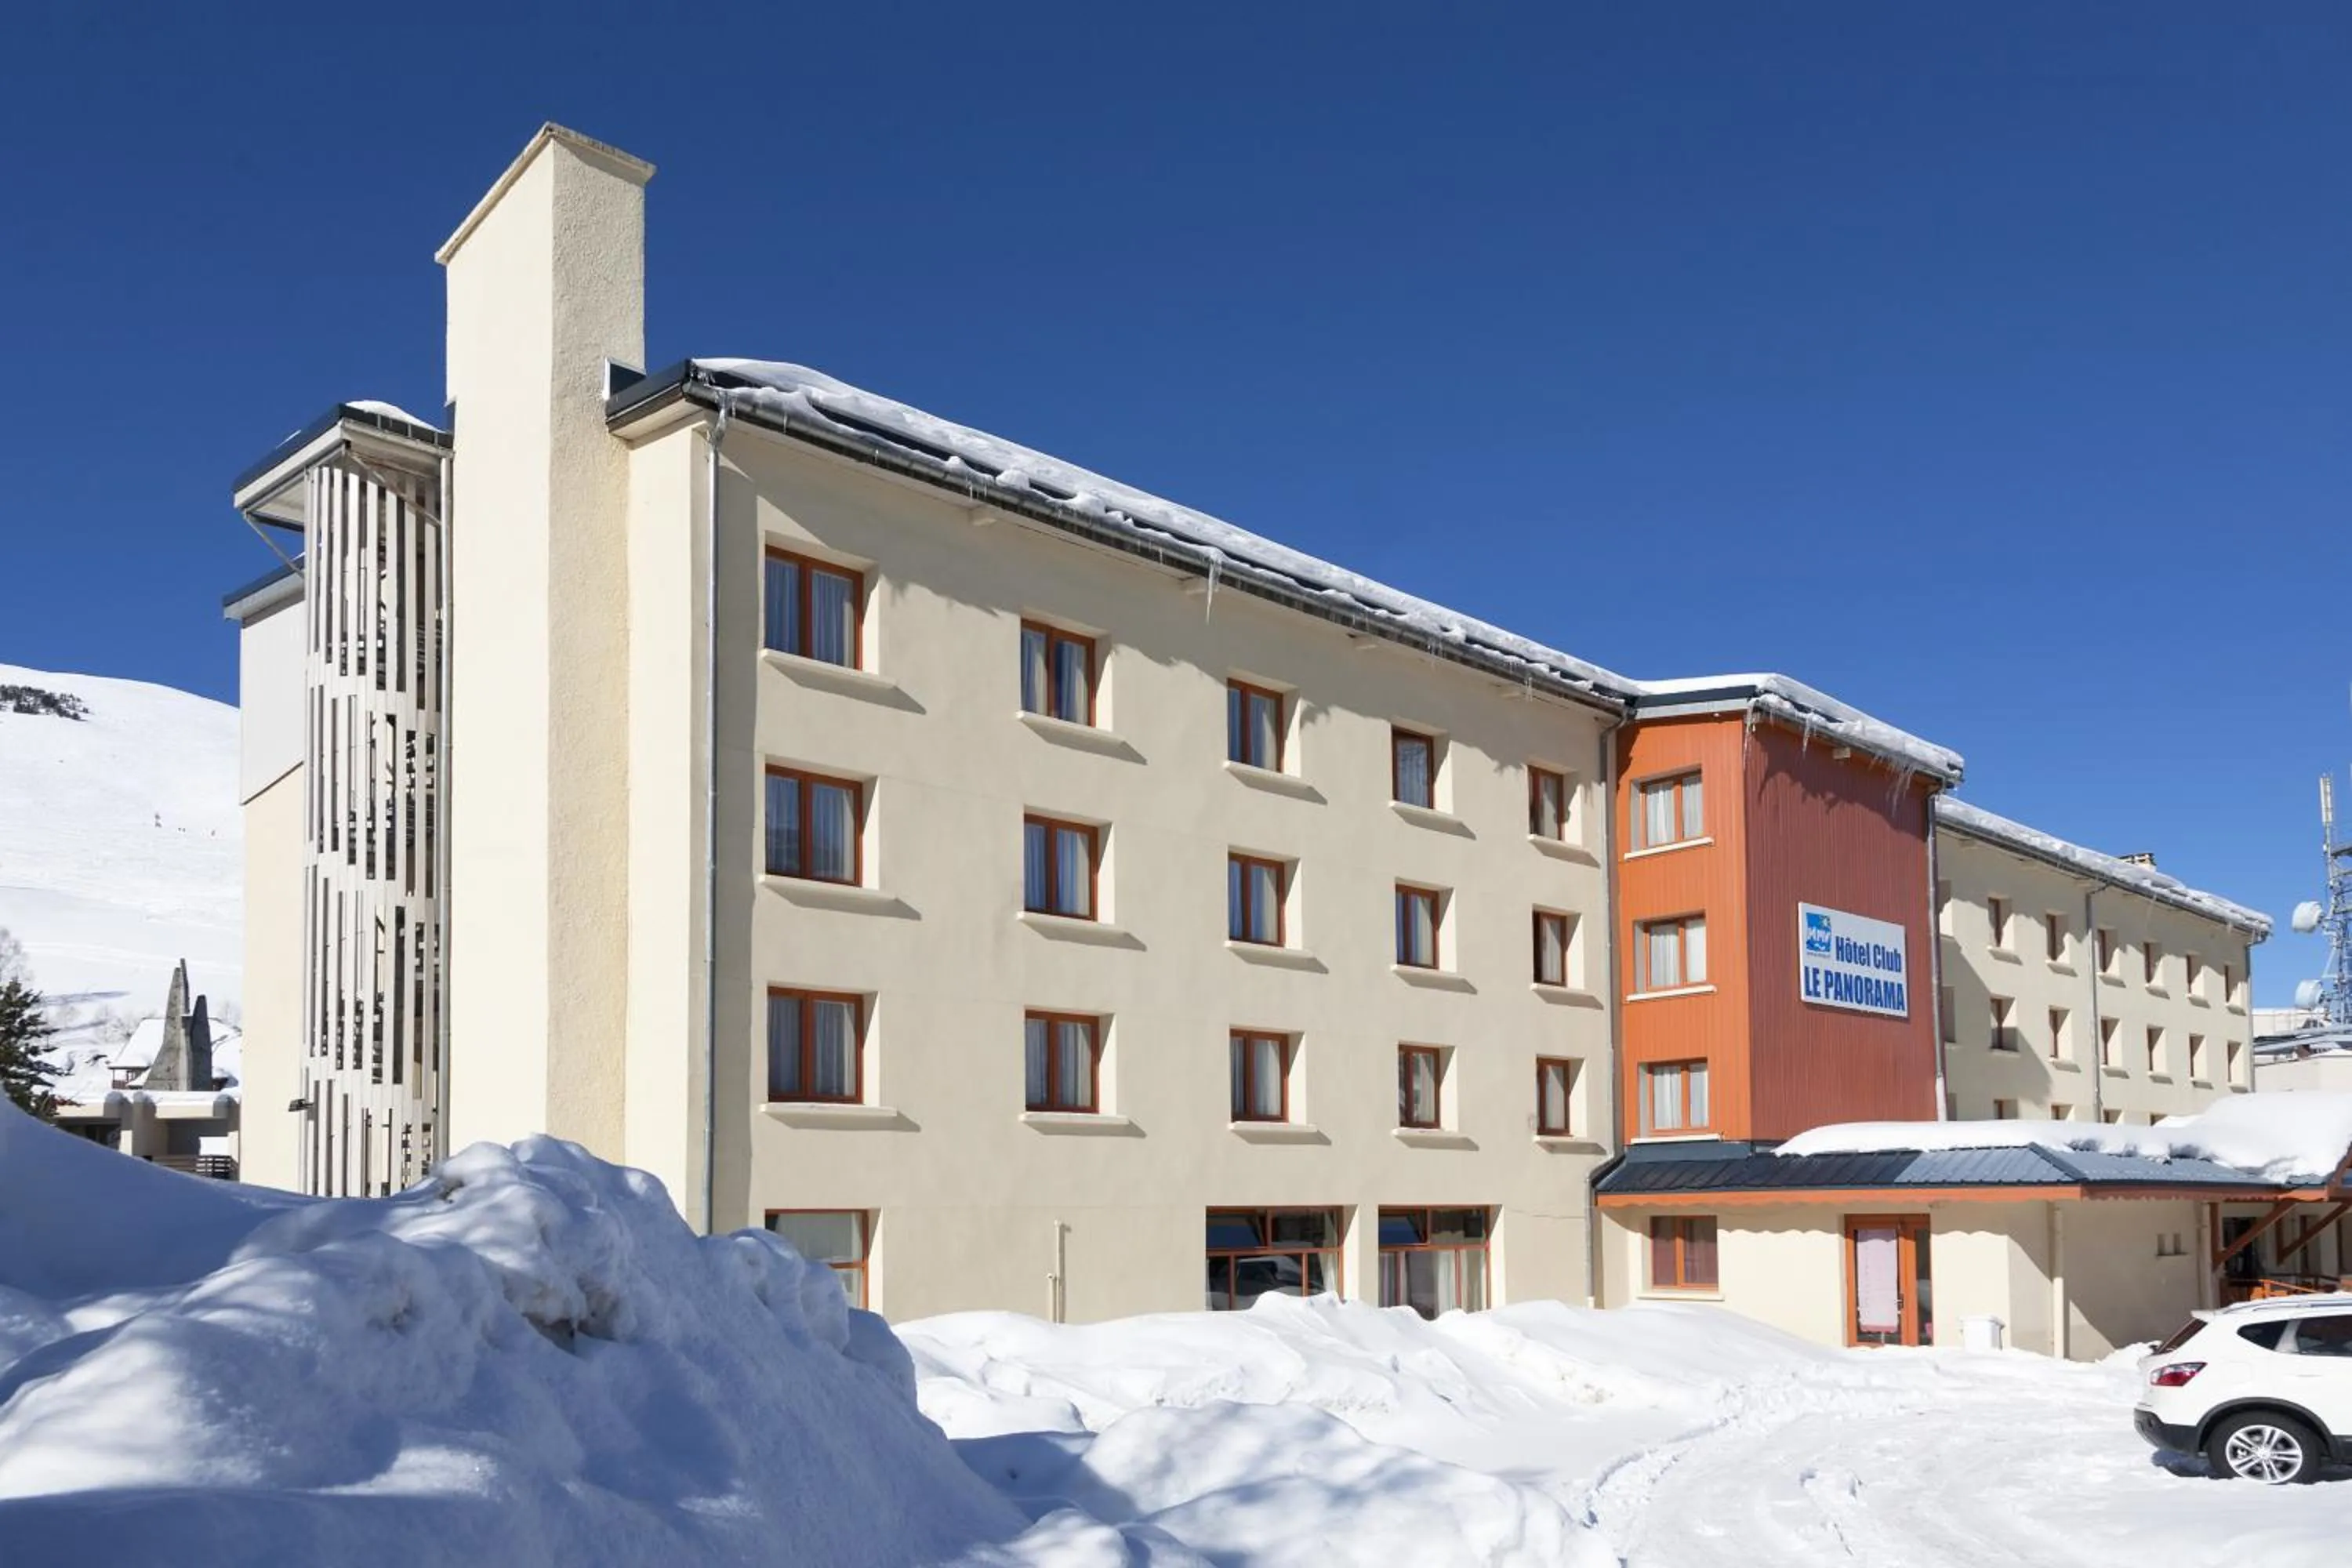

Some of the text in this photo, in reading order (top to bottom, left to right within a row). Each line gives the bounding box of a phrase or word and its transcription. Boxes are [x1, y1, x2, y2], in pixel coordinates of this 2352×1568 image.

[1835, 936, 1901, 972] Hôtel Club
[1805, 966, 1905, 1011] LE PANORAMA
